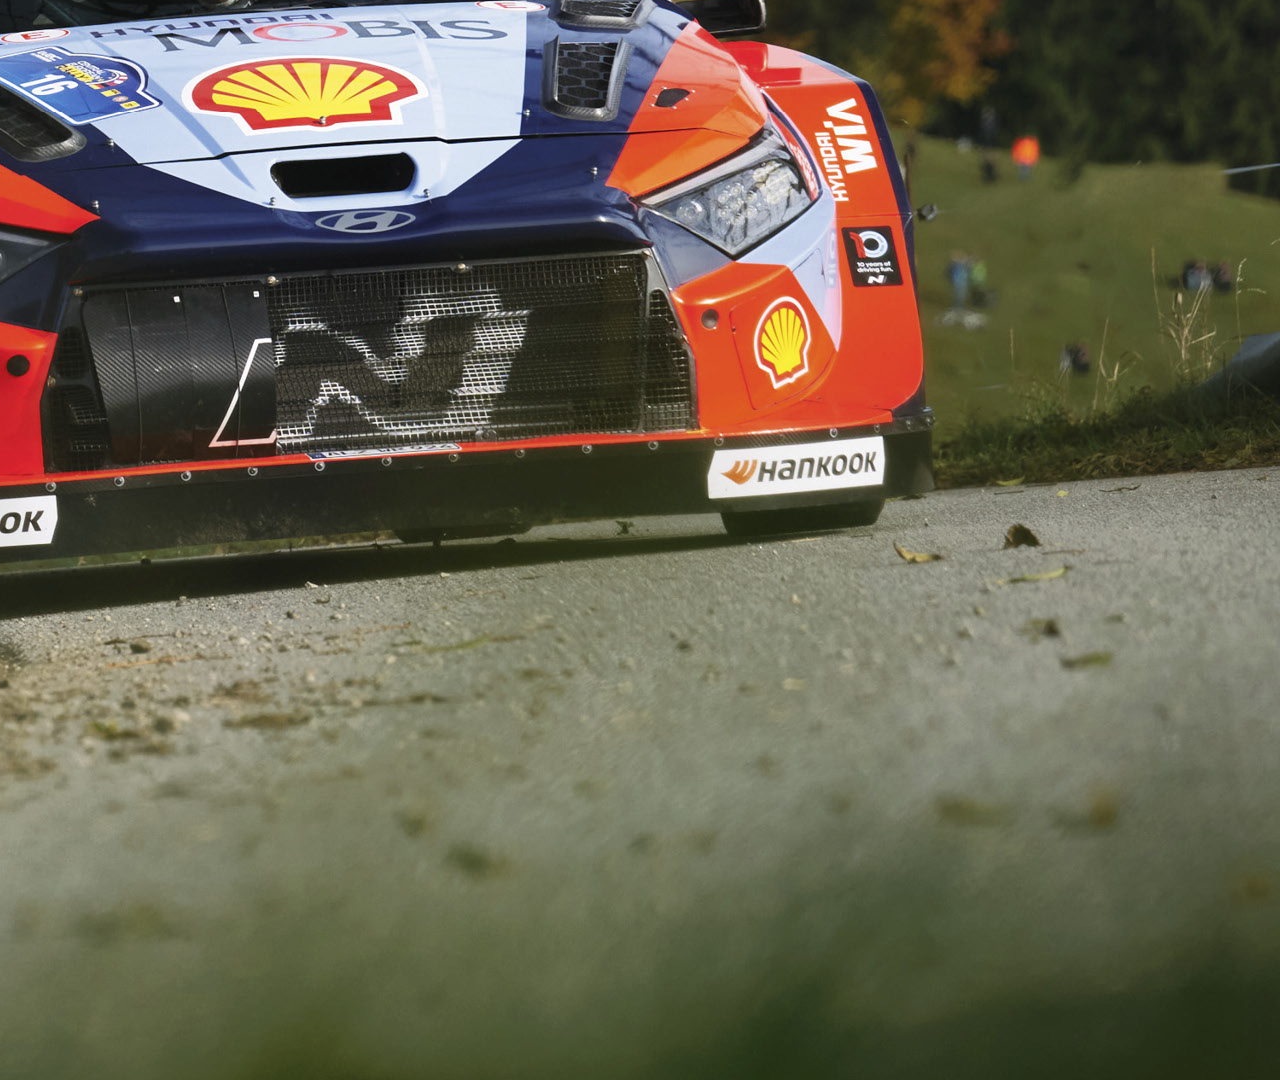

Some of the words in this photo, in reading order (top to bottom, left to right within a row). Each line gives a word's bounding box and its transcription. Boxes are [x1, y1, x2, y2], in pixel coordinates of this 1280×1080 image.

[90, 13, 333, 38] HYUNDAI
[152, 20, 507, 52] MOBIS
[20, 73, 79, 96] 16
[814, 132, 849, 202] HYUNDAI
